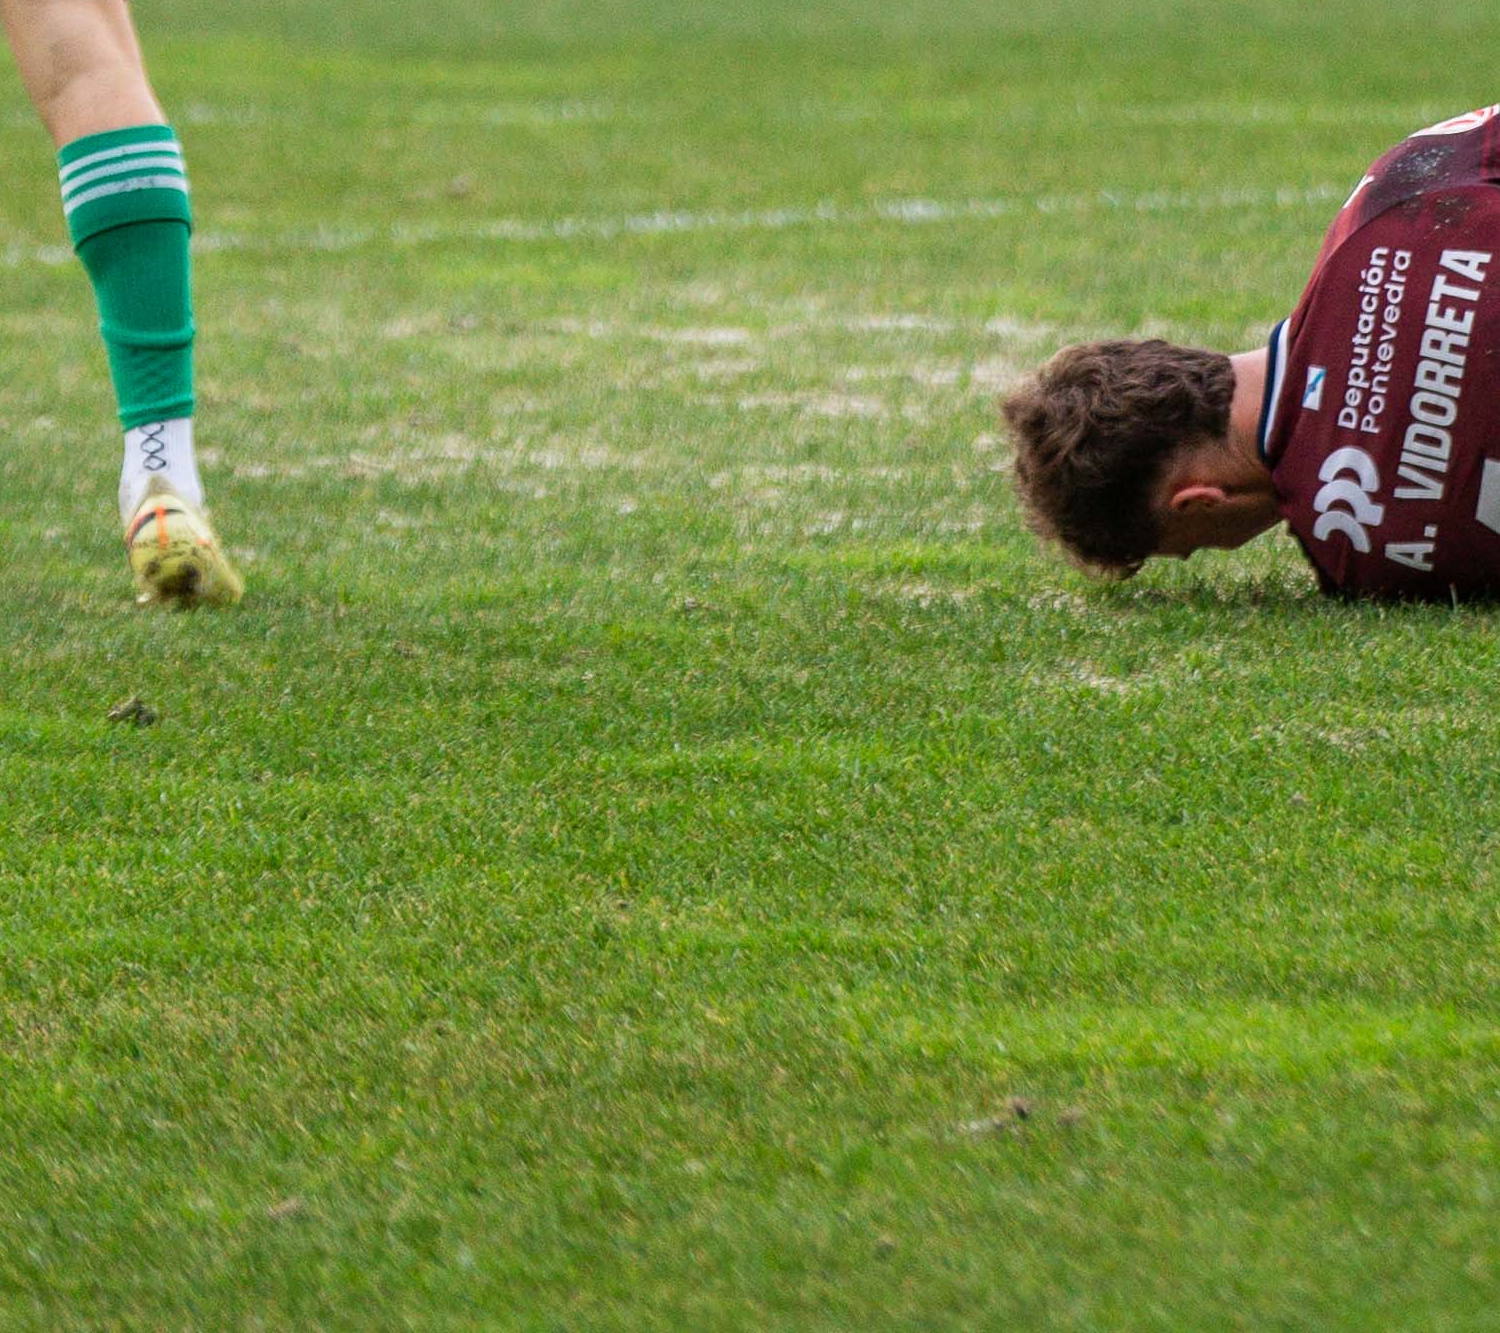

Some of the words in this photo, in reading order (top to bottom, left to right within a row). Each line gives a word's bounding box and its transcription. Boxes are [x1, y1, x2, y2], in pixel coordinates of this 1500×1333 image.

[1338, 247, 1389, 429] Deputación
[1361, 250, 1412, 433] Pontevedra
[1393, 249, 1492, 500] VIDORRETA
[1385, 524, 1438, 571] A.
